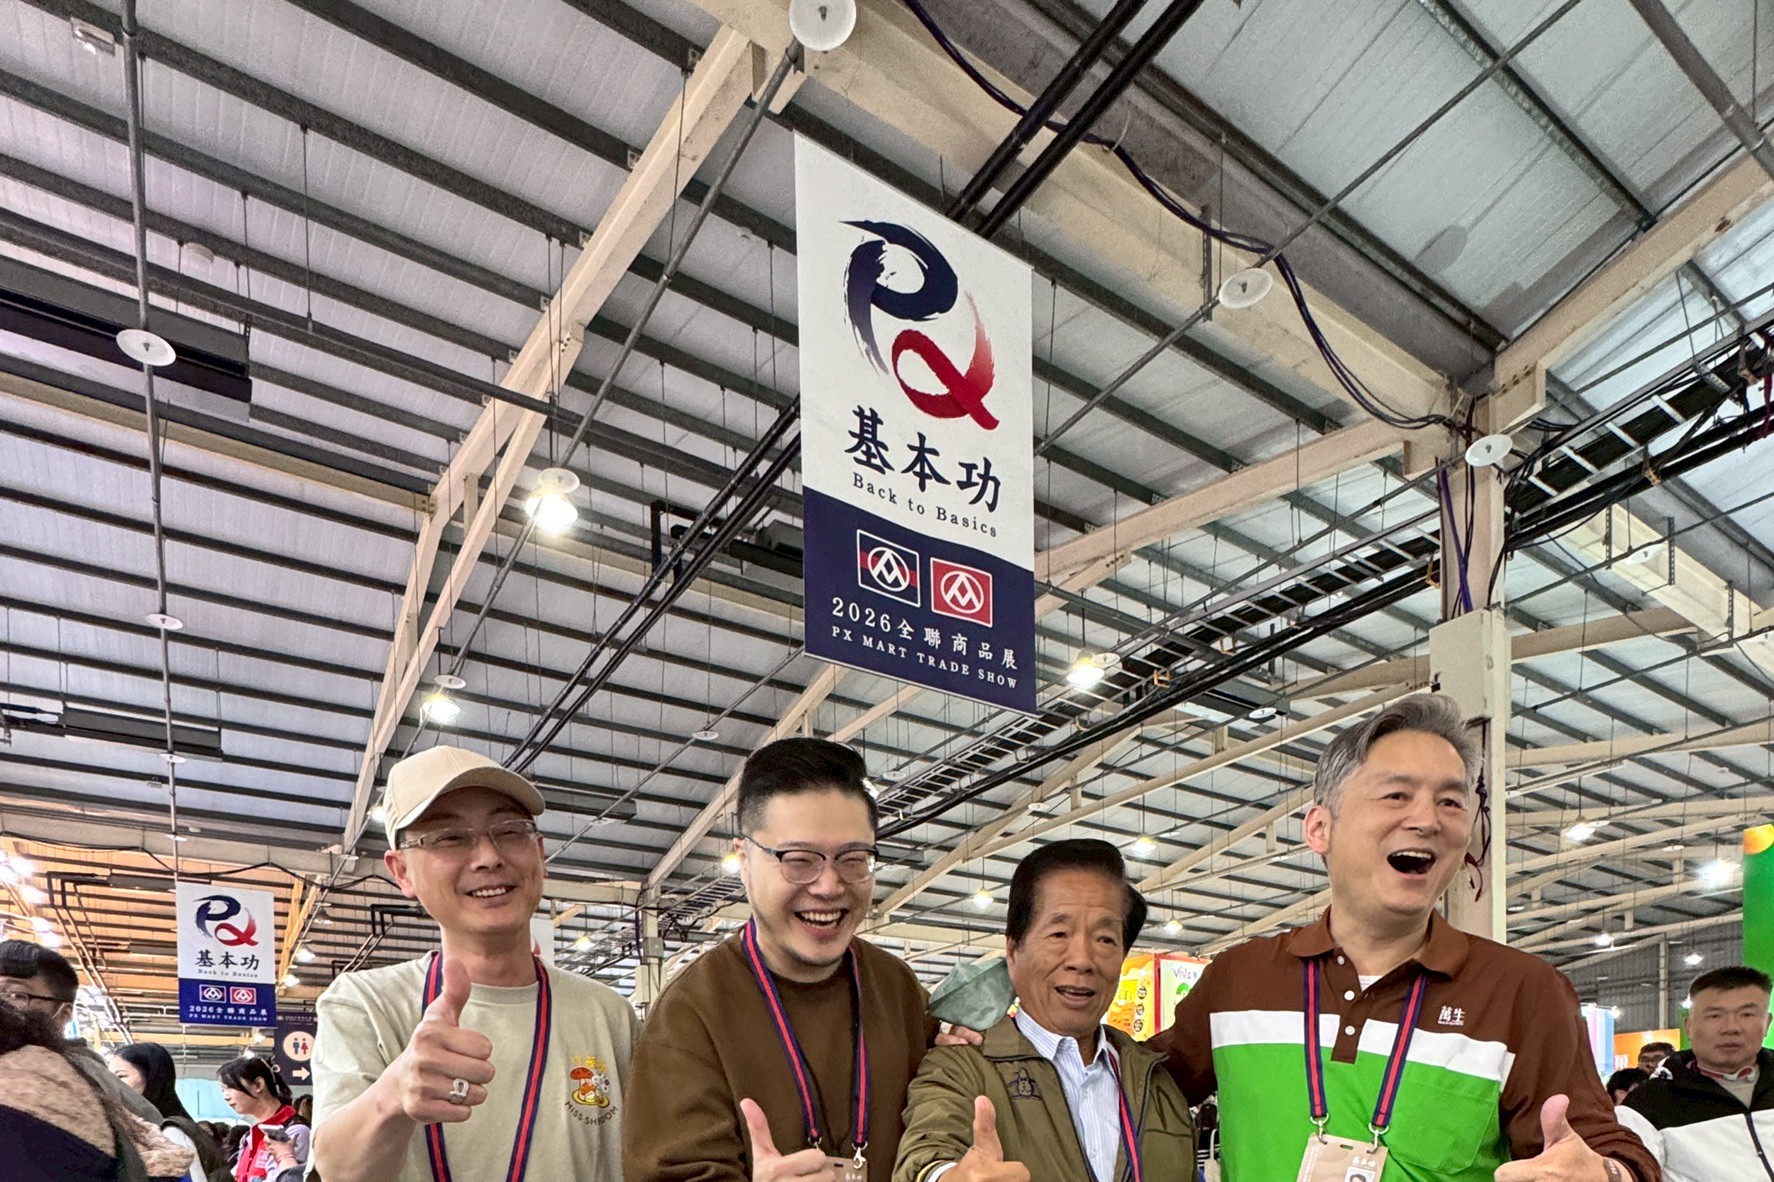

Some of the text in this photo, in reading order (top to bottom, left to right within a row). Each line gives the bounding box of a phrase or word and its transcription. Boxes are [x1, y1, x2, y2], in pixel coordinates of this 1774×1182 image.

[844, 405, 1001, 513] 基本功
[853, 472, 997, 538] Back to Basics
[832, 597, 1018, 670] 2026全聯商品展
[832, 626, 1017, 689] PX MART TRADE SHOW
[195, 949, 259, 970] 基本功
[565, 1101, 583, 1121] MISS
